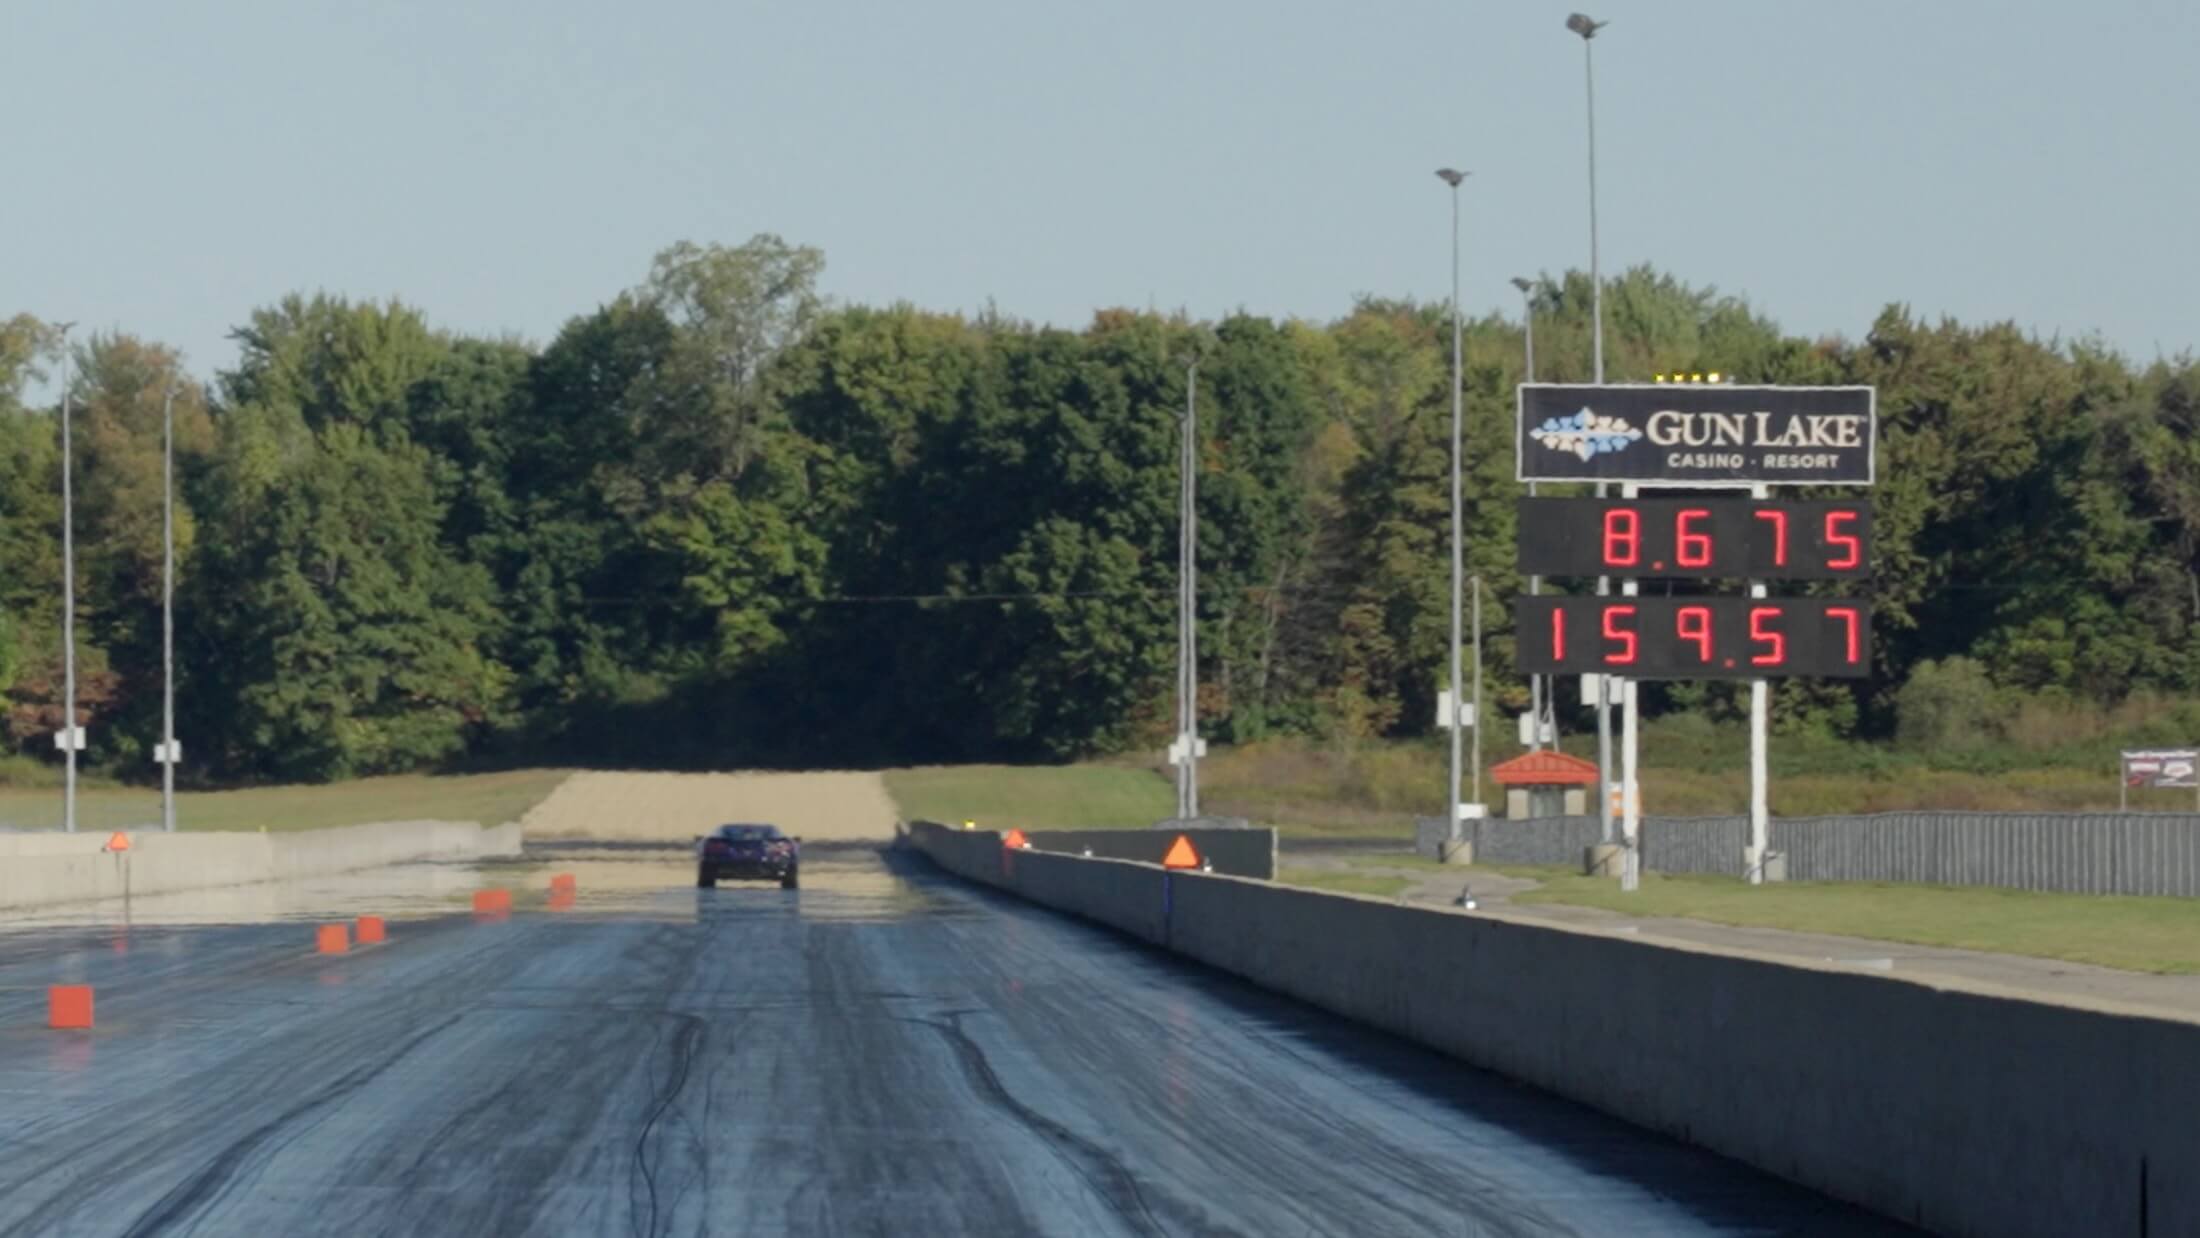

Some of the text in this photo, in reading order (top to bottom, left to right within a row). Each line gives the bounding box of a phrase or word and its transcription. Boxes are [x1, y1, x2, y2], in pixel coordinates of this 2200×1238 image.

[1646, 411, 1862, 448] GUN LAKE
[1667, 452, 1839, 469] CASINO RESORT
[1603, 508, 1862, 568] 8.675
[1551, 605, 1862, 667] 159.57
